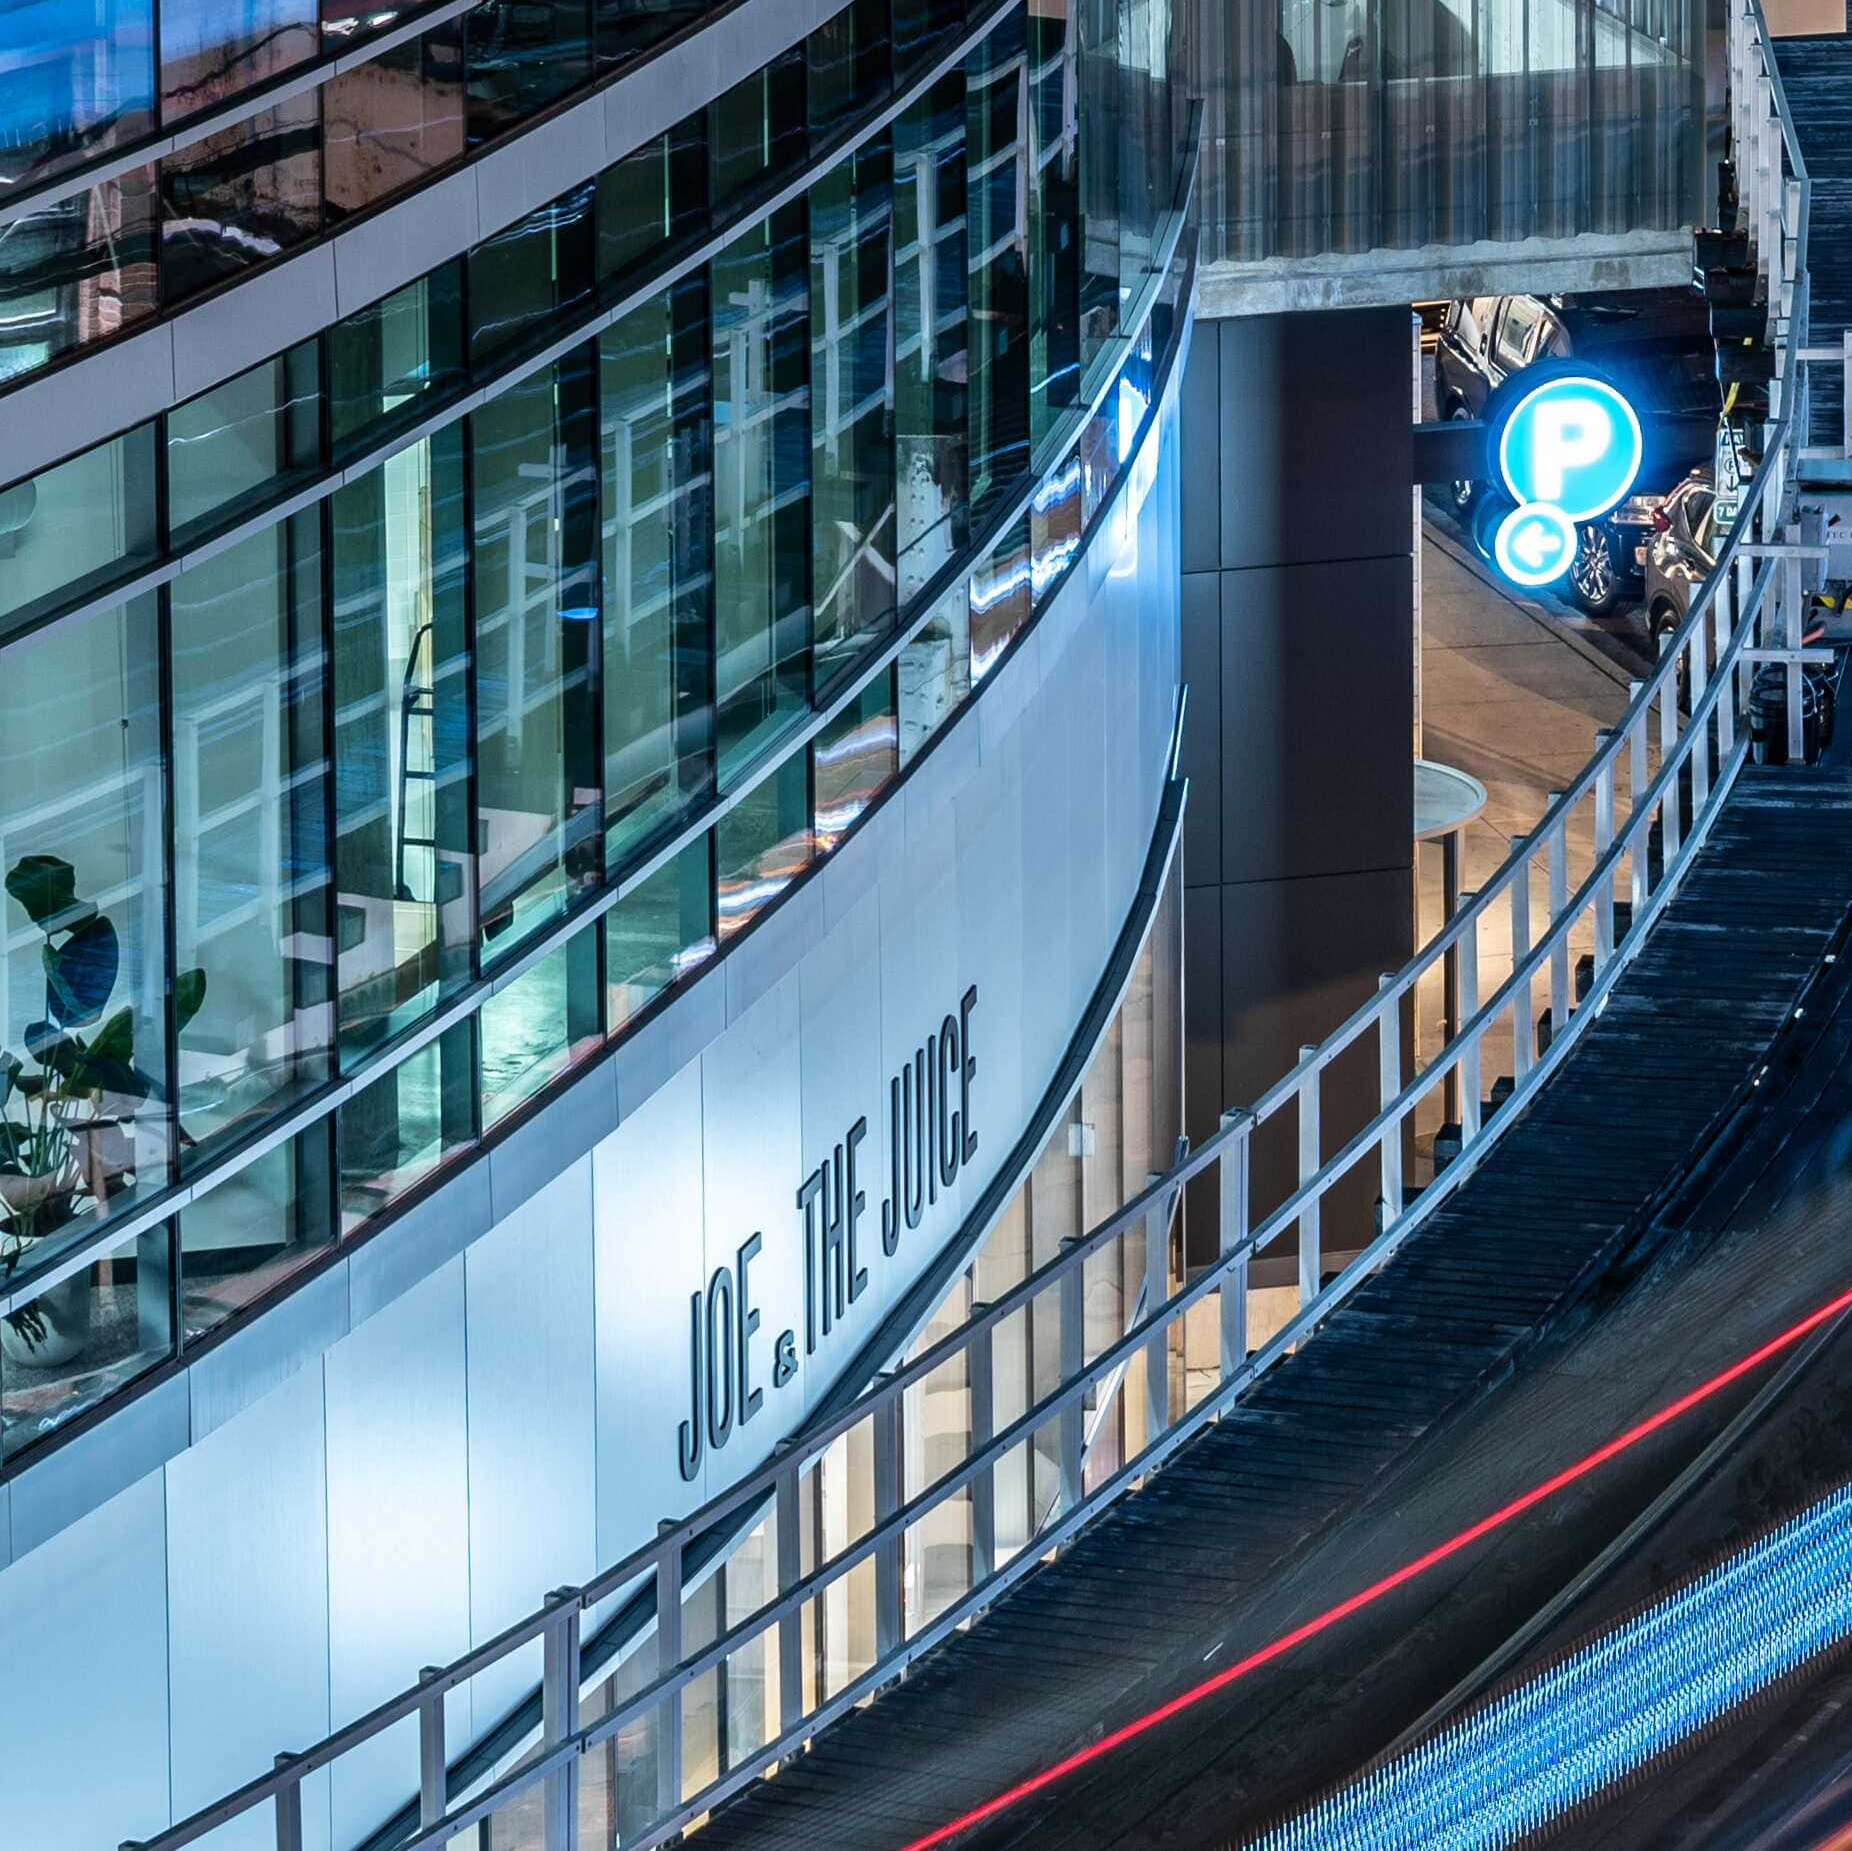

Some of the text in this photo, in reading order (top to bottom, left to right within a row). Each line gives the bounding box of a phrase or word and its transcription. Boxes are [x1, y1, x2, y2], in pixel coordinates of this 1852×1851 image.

[1533, 398, 1614, 501] P
[679, 983, 979, 1482] JOE & THE JUICE
